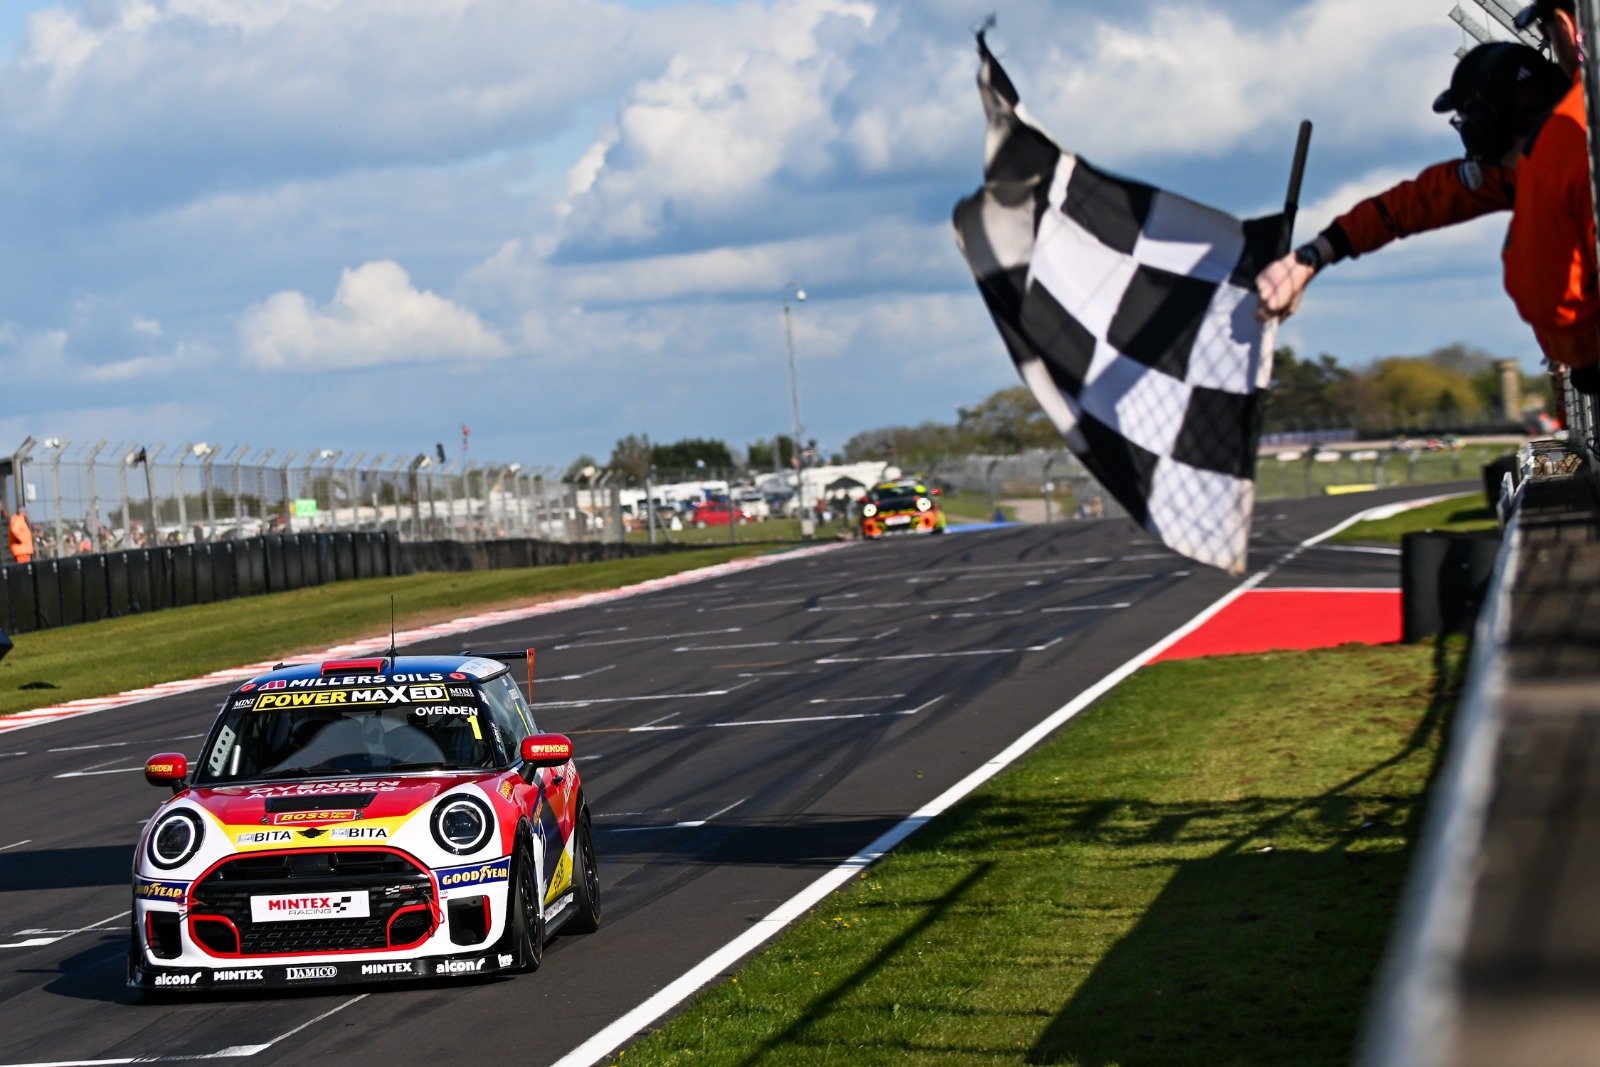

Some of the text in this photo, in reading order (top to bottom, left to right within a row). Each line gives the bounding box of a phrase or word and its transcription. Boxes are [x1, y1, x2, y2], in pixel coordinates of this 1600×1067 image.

[289, 673, 444, 688] MILLERS OILS
[234, 698, 255, 706] MINI
[258, 685, 443, 708] POWER MAXED
[415, 706, 478, 717] OVENDEN
[467, 715, 483, 740] 1
[531, 745, 568, 753] OVENDEN
[245, 786, 396, 800] ALLWORKS
[249, 781, 400, 793] OVENDEN
[280, 812, 329, 822] BOSS
[254, 830, 291, 842] BITA
[349, 828, 387, 838] BITA
[442, 866, 508, 885] GOODYEAR
[269, 897, 331, 910] MINTEX
[289, 908, 332, 916] RACING
[361, 962, 412, 975] MINTEX
[436, 960, 475, 973] alcon
[155, 973, 190, 985] alcon
[214, 970, 263, 981] MINTEX
[286, 967, 336, 979] DAMICO
